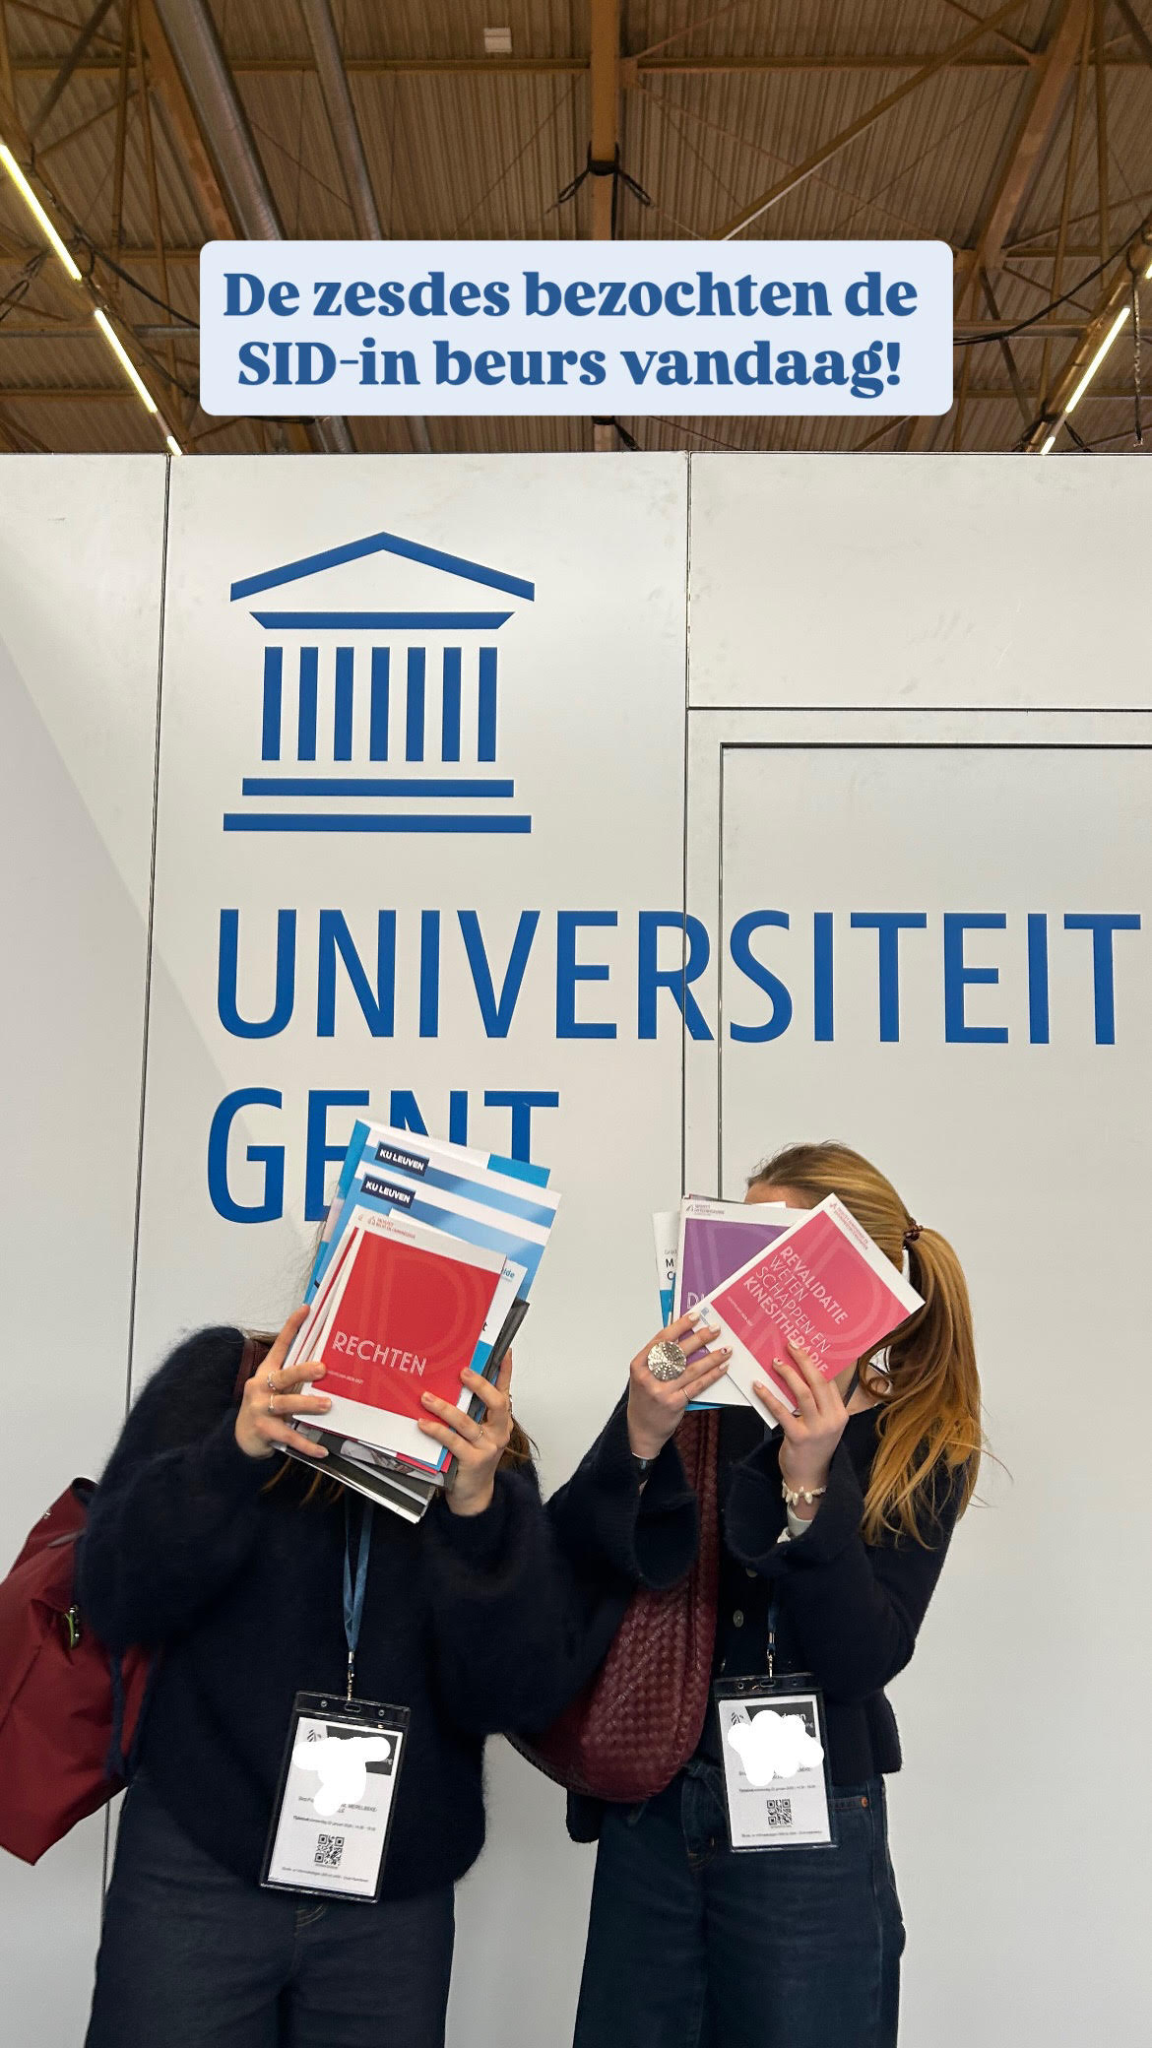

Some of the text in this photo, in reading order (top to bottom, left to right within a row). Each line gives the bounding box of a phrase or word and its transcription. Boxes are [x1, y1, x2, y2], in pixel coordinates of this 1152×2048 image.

[218, 910, 1141, 1046] UNIVERSITEIT
[379, 1148, 425, 1171] KU LEUVEN
[365, 1180, 411, 1204] KU LEUVEN
[770, 1255, 809, 1303] WETEN
[780, 1246, 849, 1325] REVALIDATIE
[755, 1266, 832, 1354] SCHAPPEN EN
[331, 1330, 427, 1377] RECHTEN
